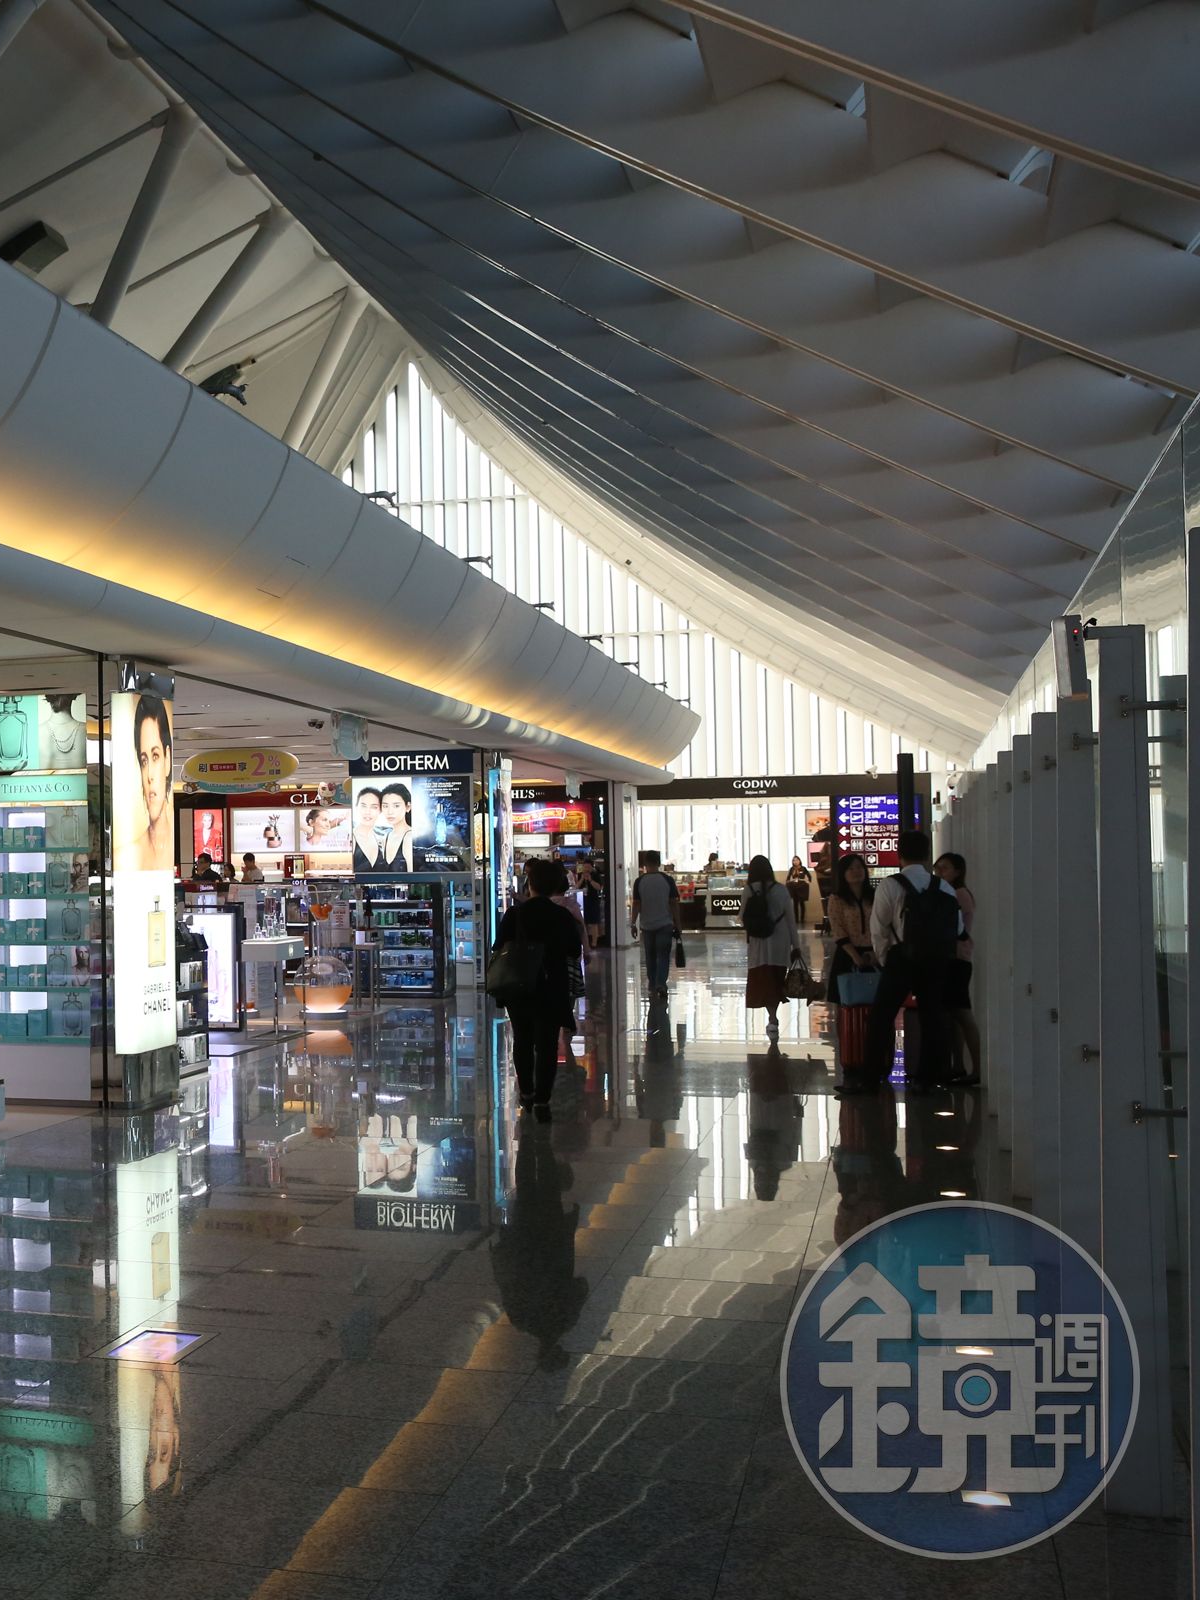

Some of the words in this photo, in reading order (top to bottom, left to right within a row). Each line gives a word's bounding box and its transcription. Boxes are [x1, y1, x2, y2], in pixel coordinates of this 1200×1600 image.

[371, 755, 450, 772] BIOTHERM
[733, 780, 778, 789] GODIVA
[713, 899, 741, 907] GODIV
[143, 998, 171, 1015] CHANEL
